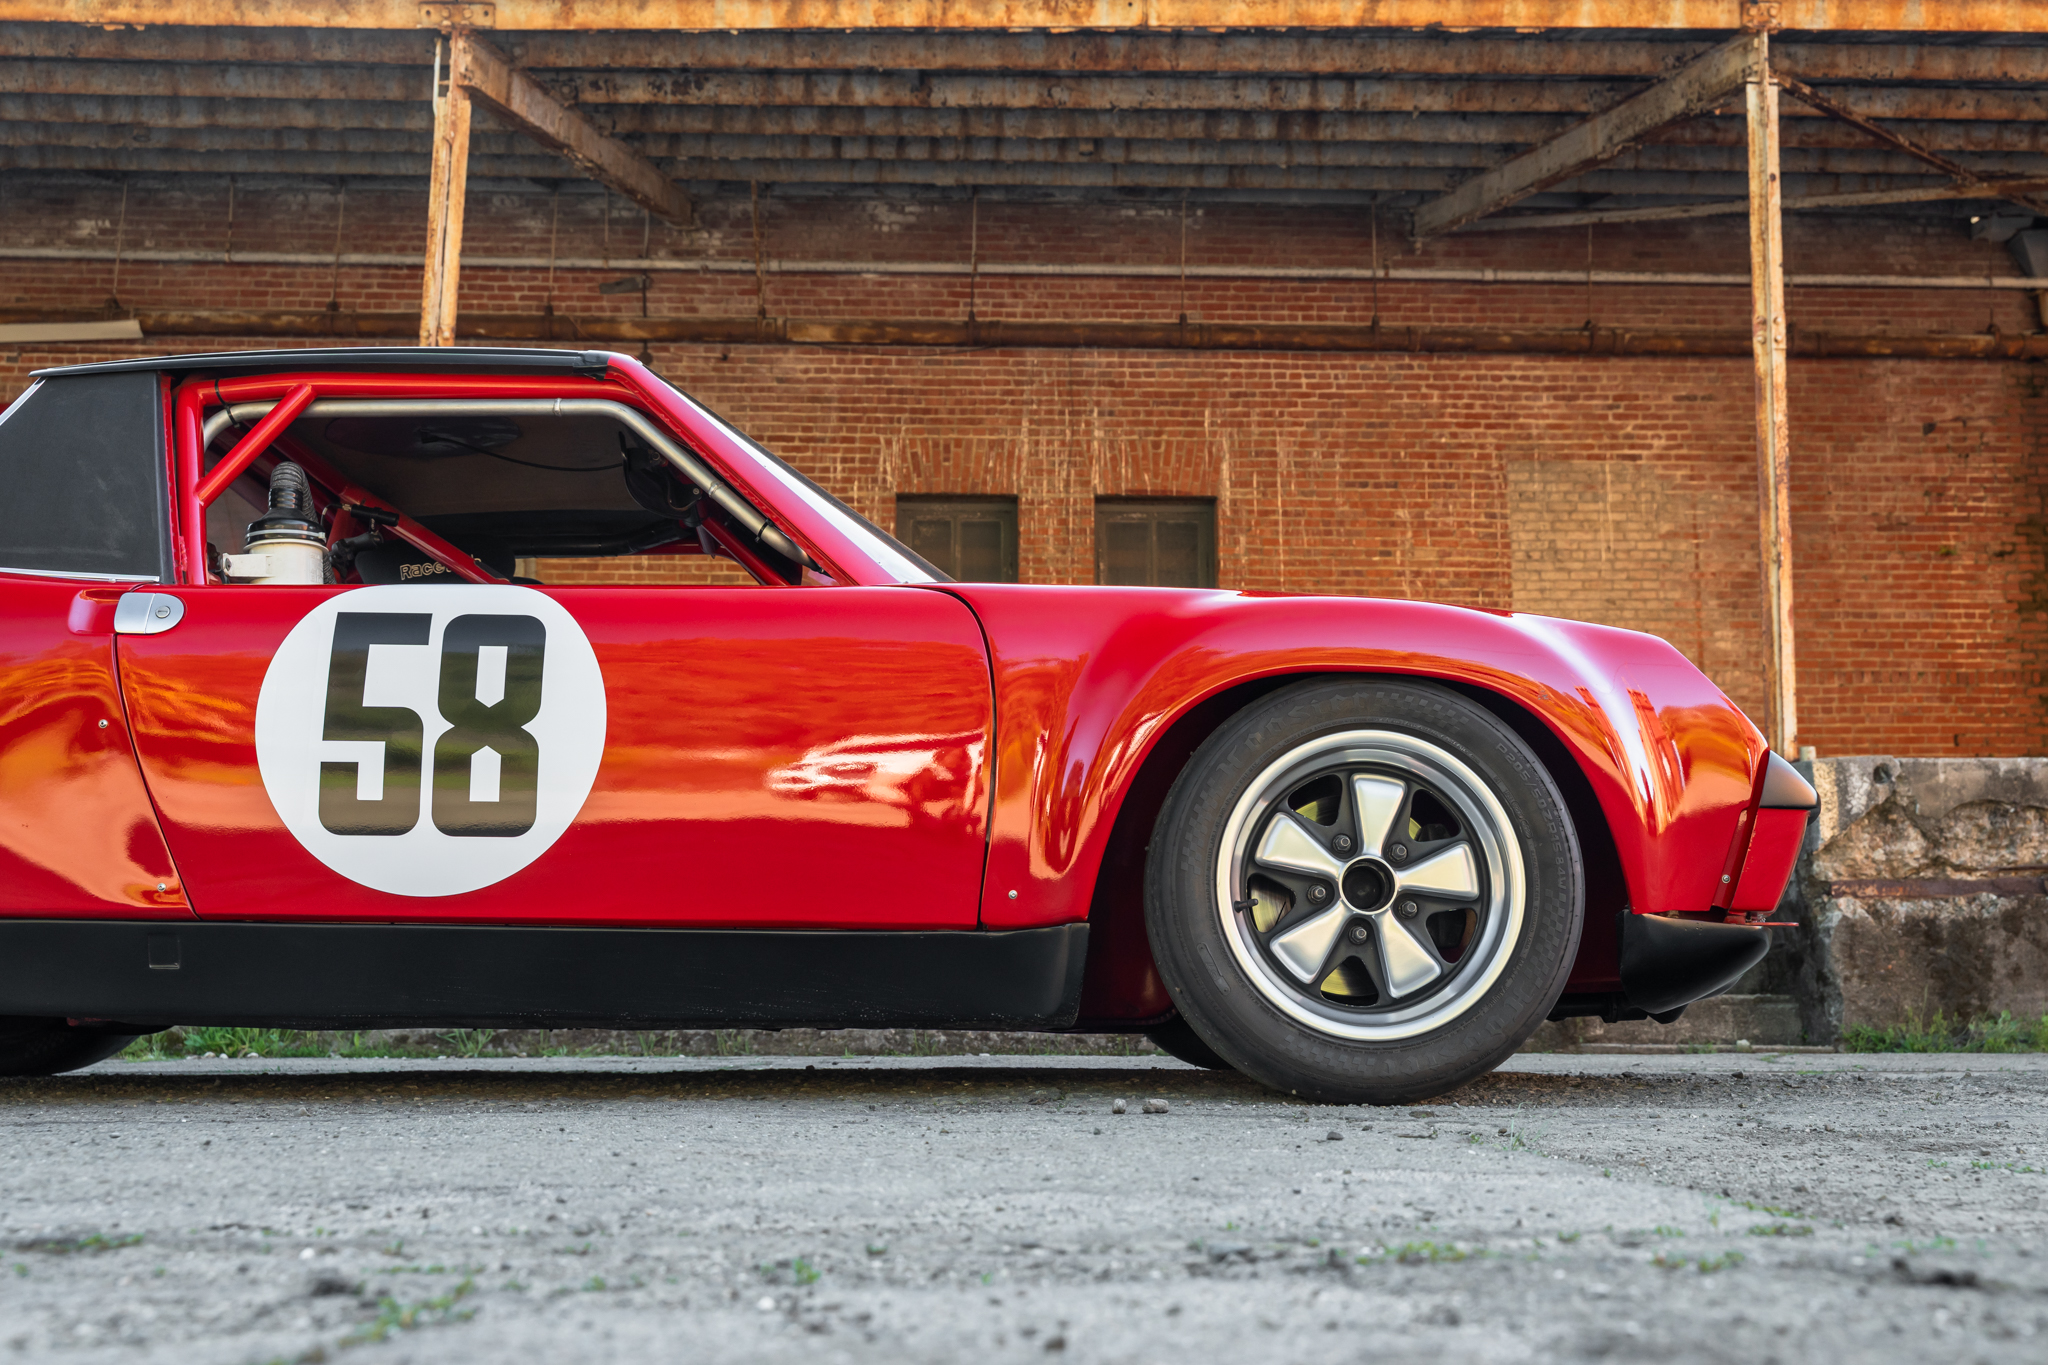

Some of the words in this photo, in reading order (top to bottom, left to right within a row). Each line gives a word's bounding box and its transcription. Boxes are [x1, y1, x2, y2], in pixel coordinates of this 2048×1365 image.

[318, 612, 546, 837] 58
[1215, 691, 1369, 779] Hoosier
[1494, 741, 1561, 852] P205/50ZR15
[1554, 855, 1566, 888] 84W
